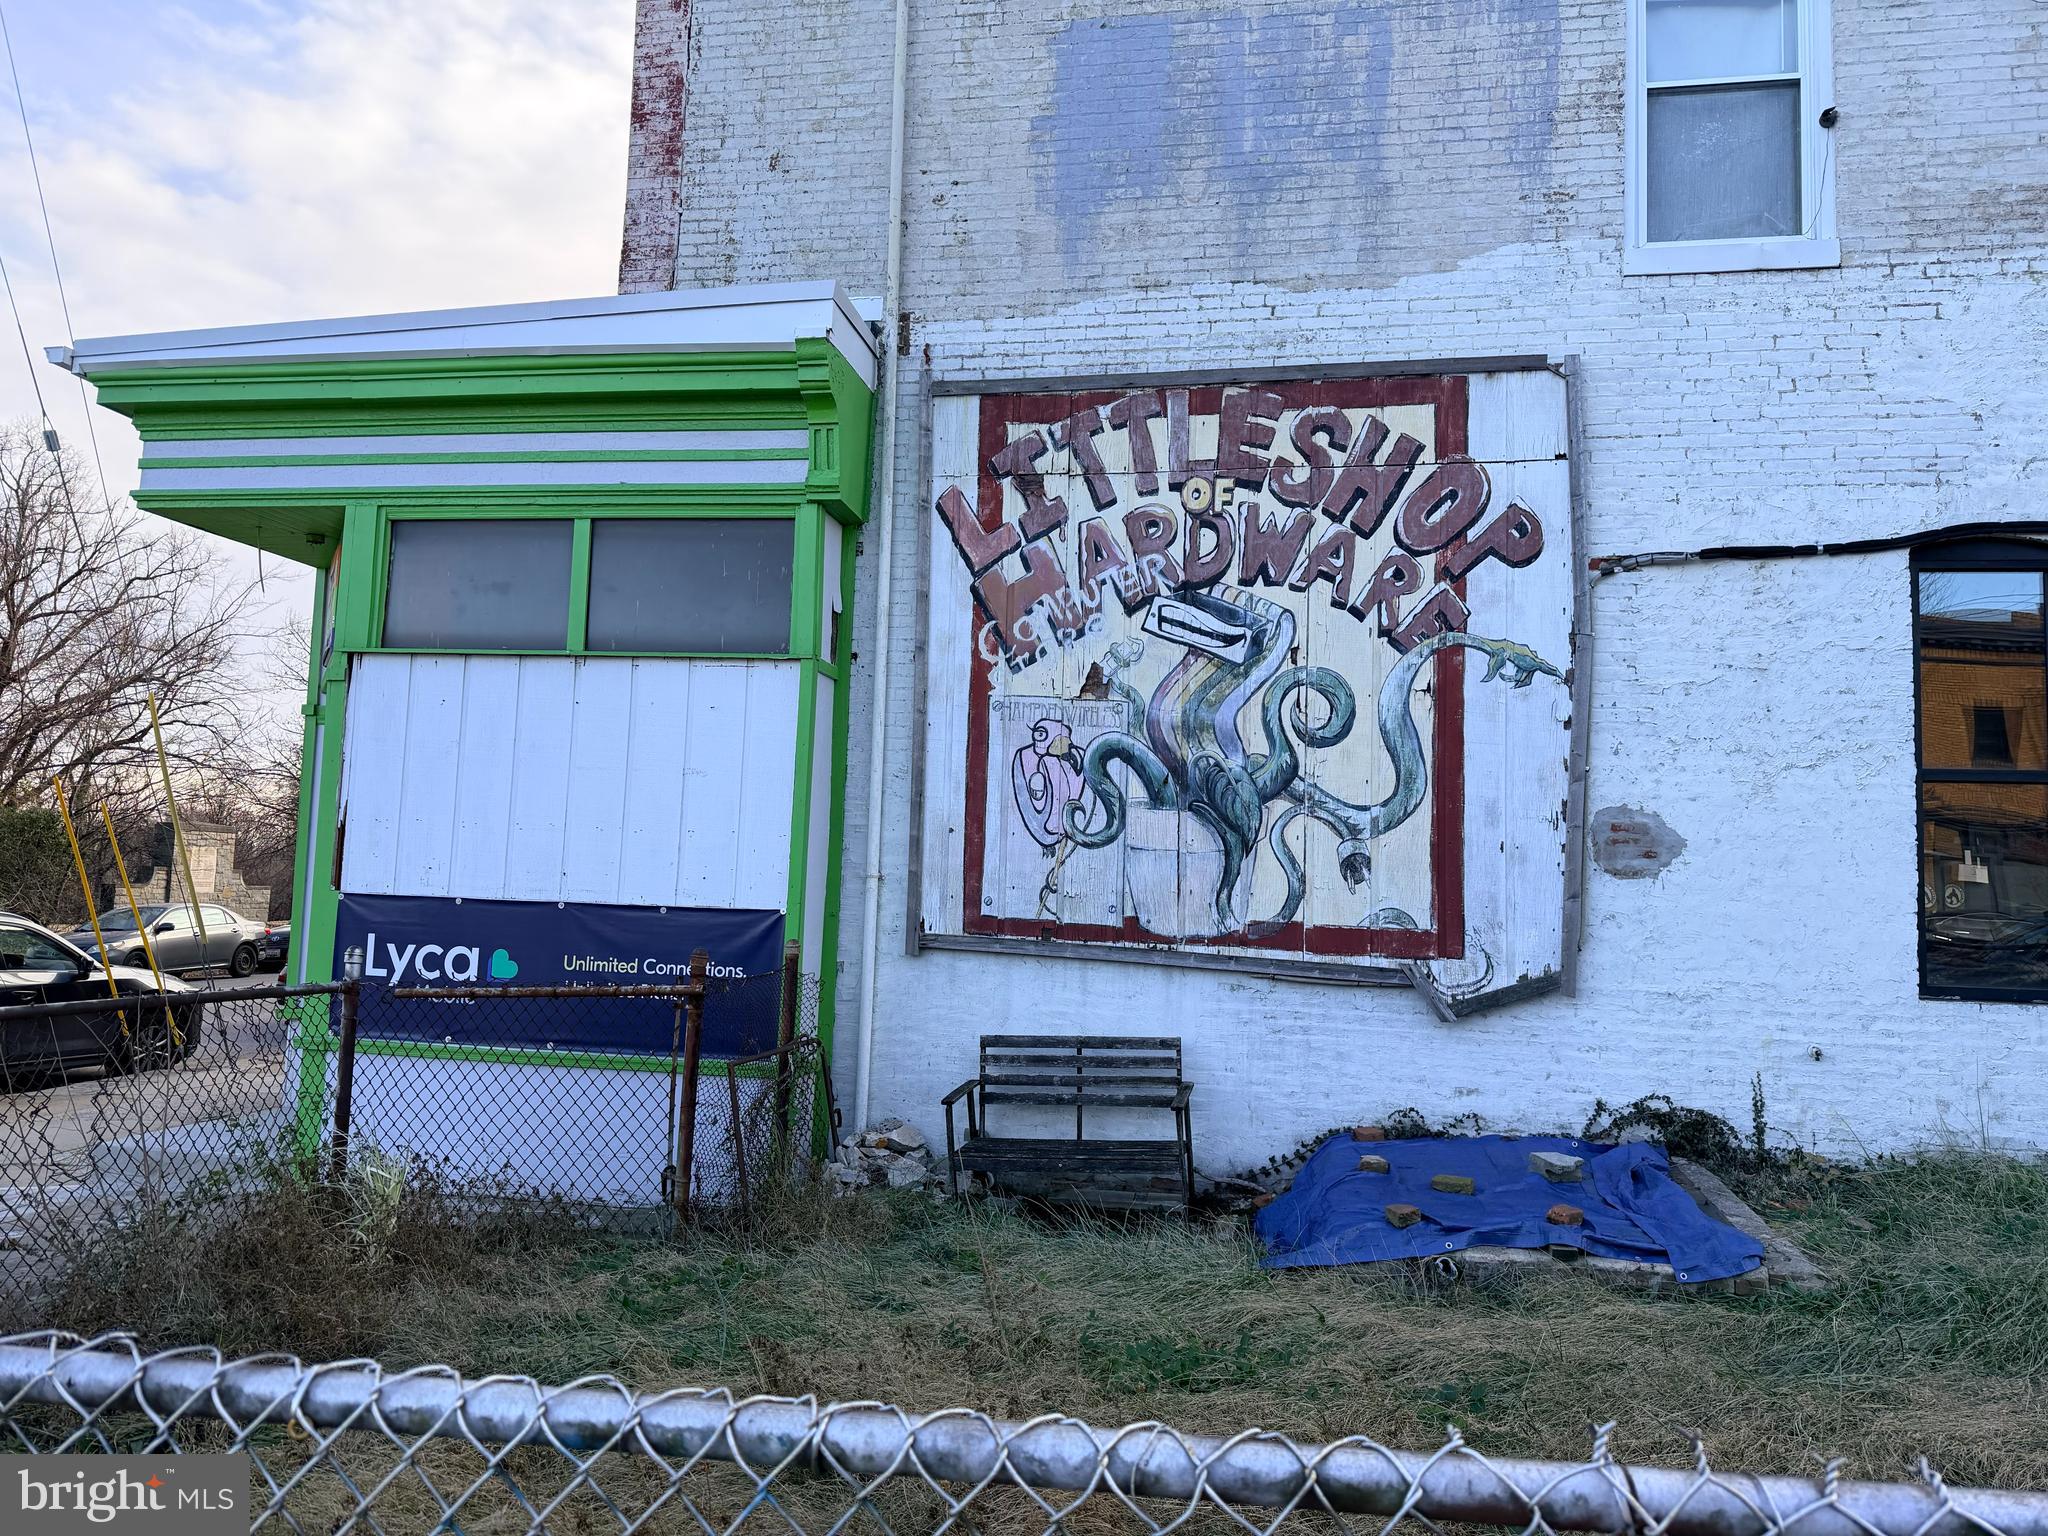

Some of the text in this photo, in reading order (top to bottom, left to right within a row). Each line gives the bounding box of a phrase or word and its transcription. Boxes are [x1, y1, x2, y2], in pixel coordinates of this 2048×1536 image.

[935, 387, 1545, 582] LITTLE SHOP
[1180, 477, 1237, 513] OF
[970, 502, 1472, 675] HARDWARE
[366, 932, 480, 986] Lyca
[563, 955, 747, 978] Unlimited Connetions.
